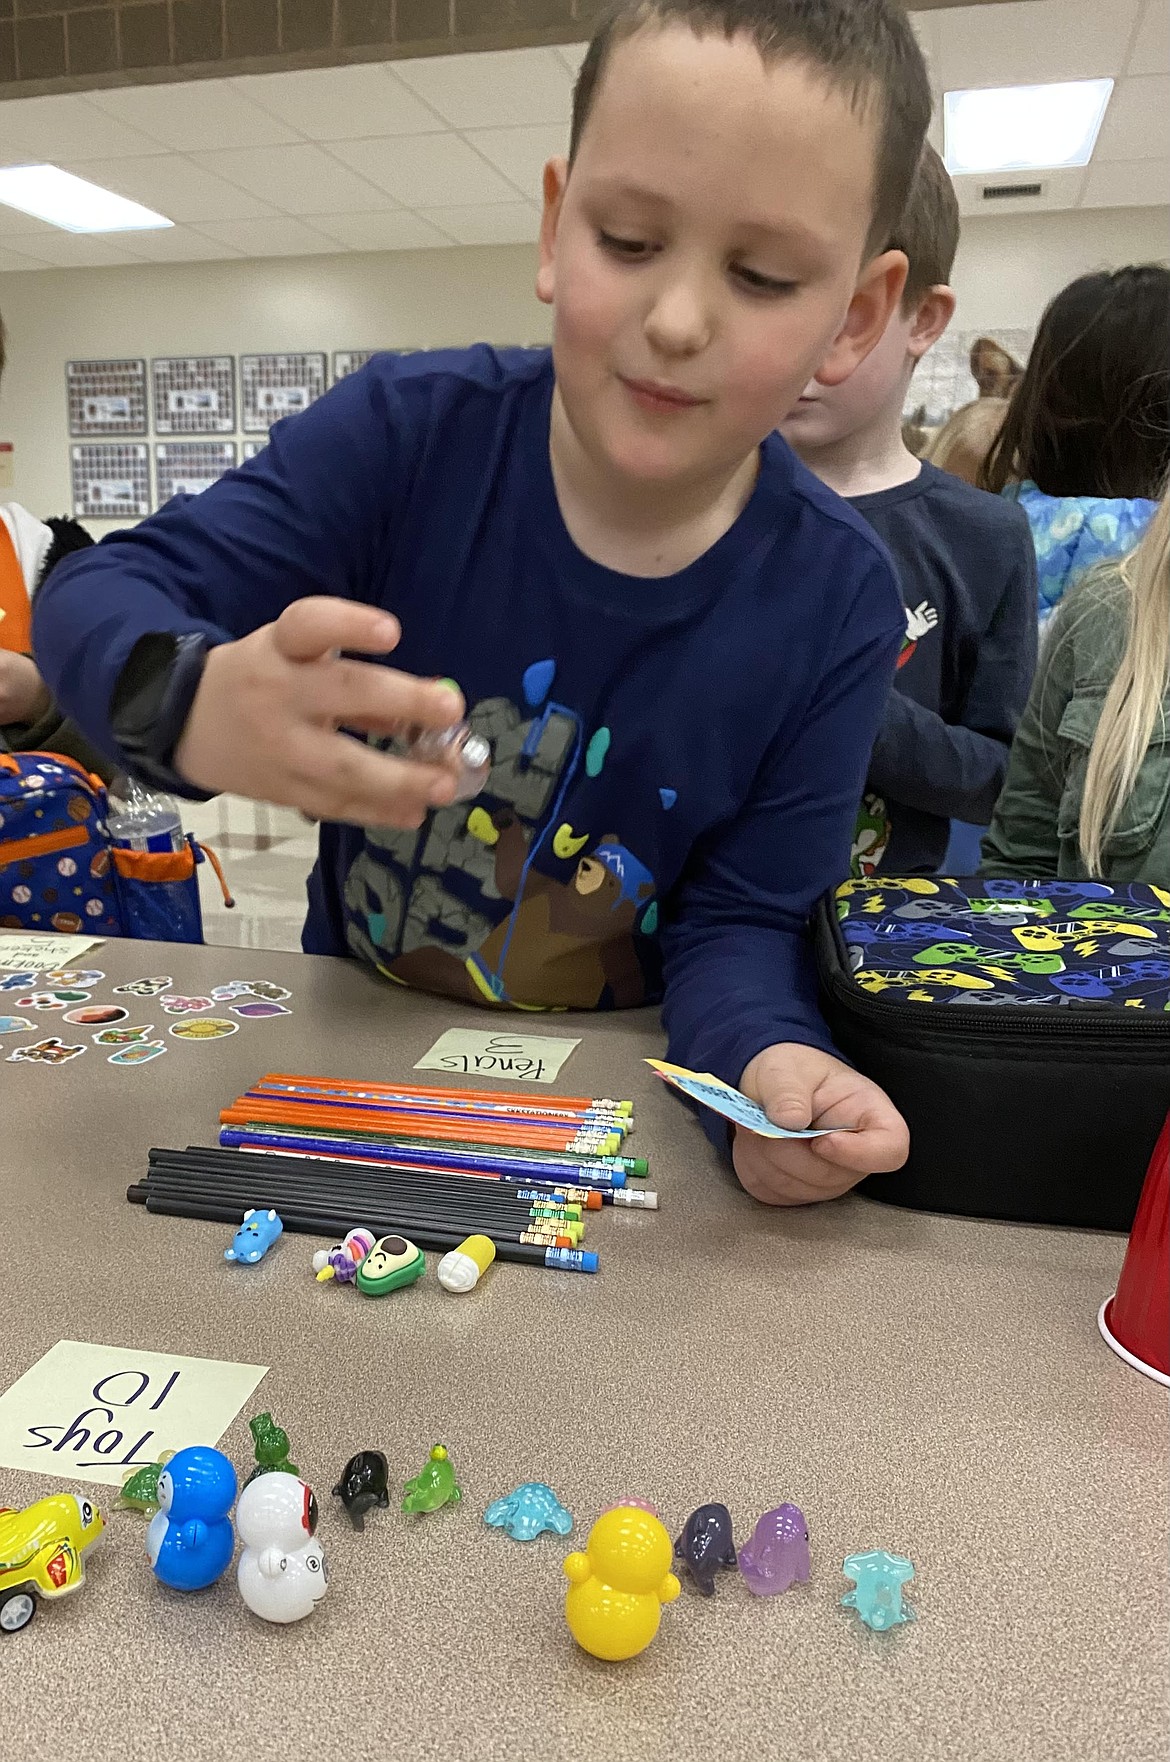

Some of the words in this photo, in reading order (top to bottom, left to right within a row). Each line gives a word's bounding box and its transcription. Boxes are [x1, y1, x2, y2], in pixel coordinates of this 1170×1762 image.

[484, 1035, 548, 1054] 3
[440, 1055, 546, 1080] Pencils
[92, 1370, 181, 1410] 10
[22, 1407, 157, 1467] Toys
